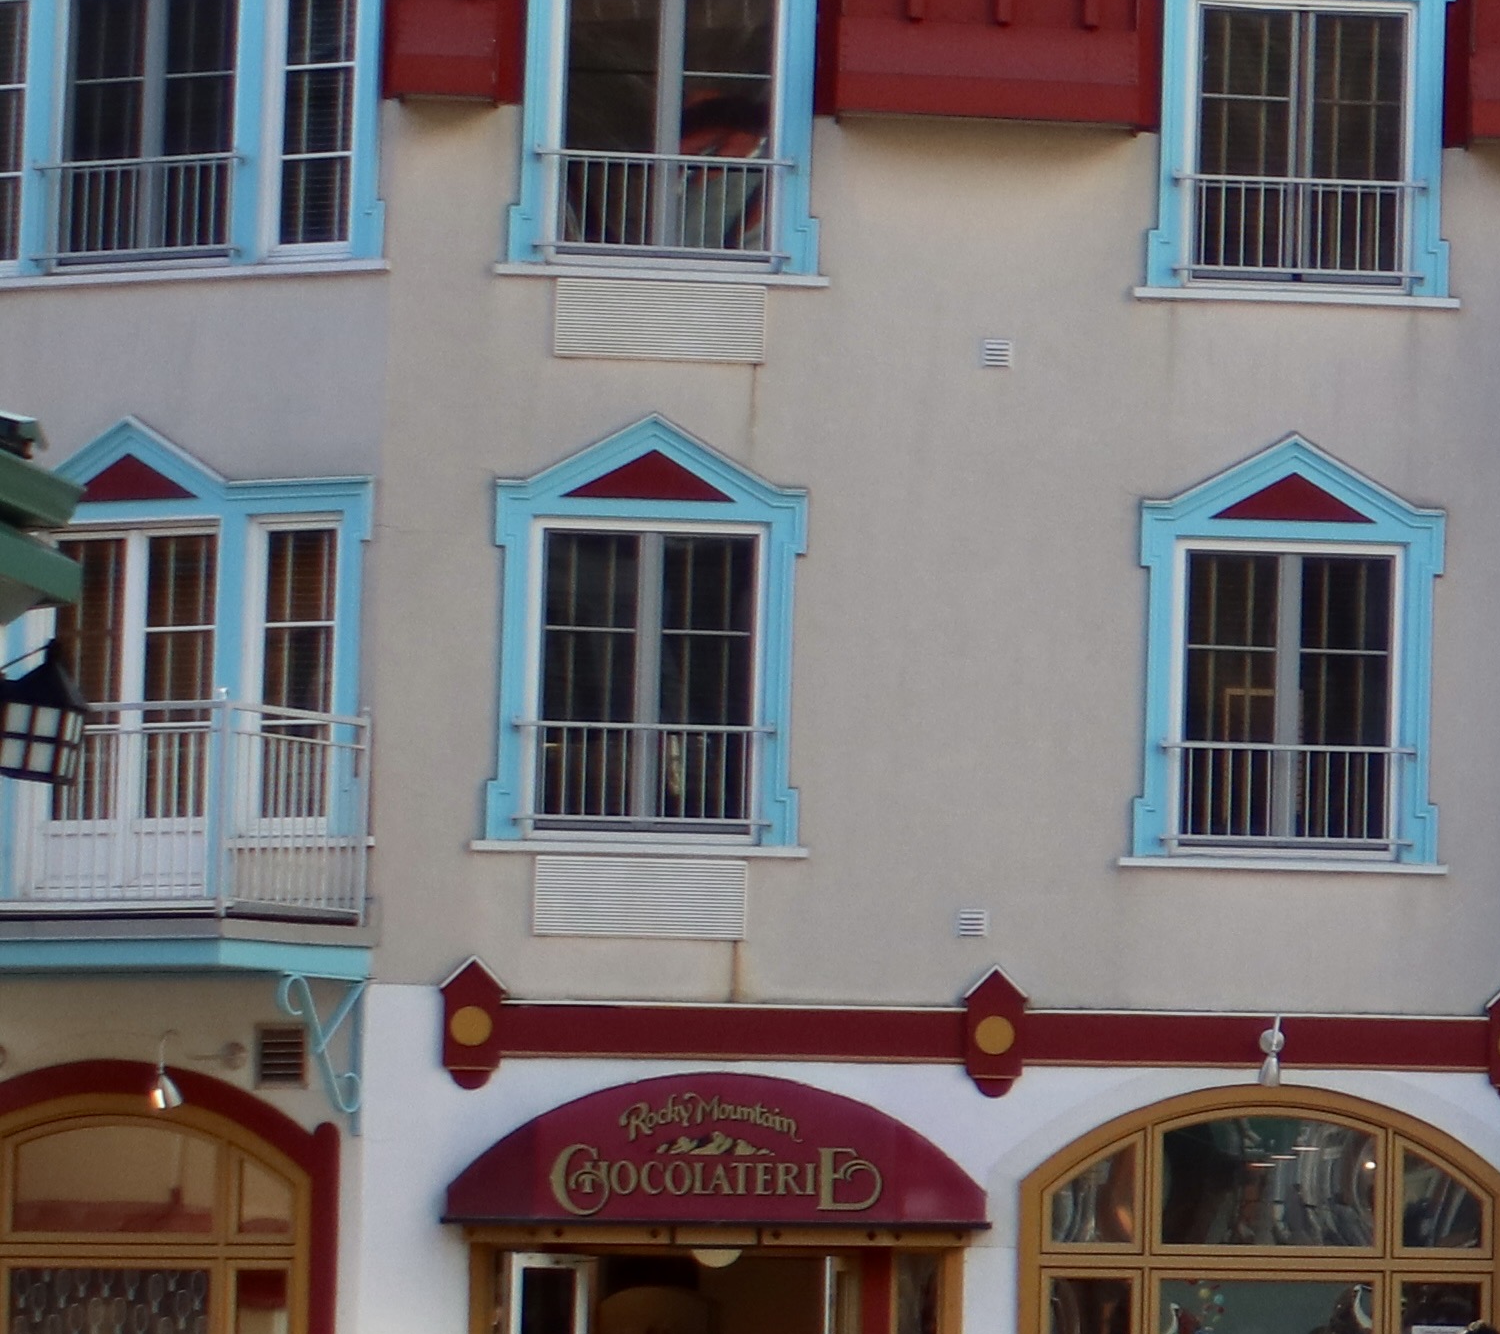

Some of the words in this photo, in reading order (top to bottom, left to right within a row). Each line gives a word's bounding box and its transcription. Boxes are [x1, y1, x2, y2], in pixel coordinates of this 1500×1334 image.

[619, 1093, 691, 1142] Rocky
[685, 1091, 803, 1143] Mountain
[550, 1143, 883, 1216] CHOCOLATERIE
